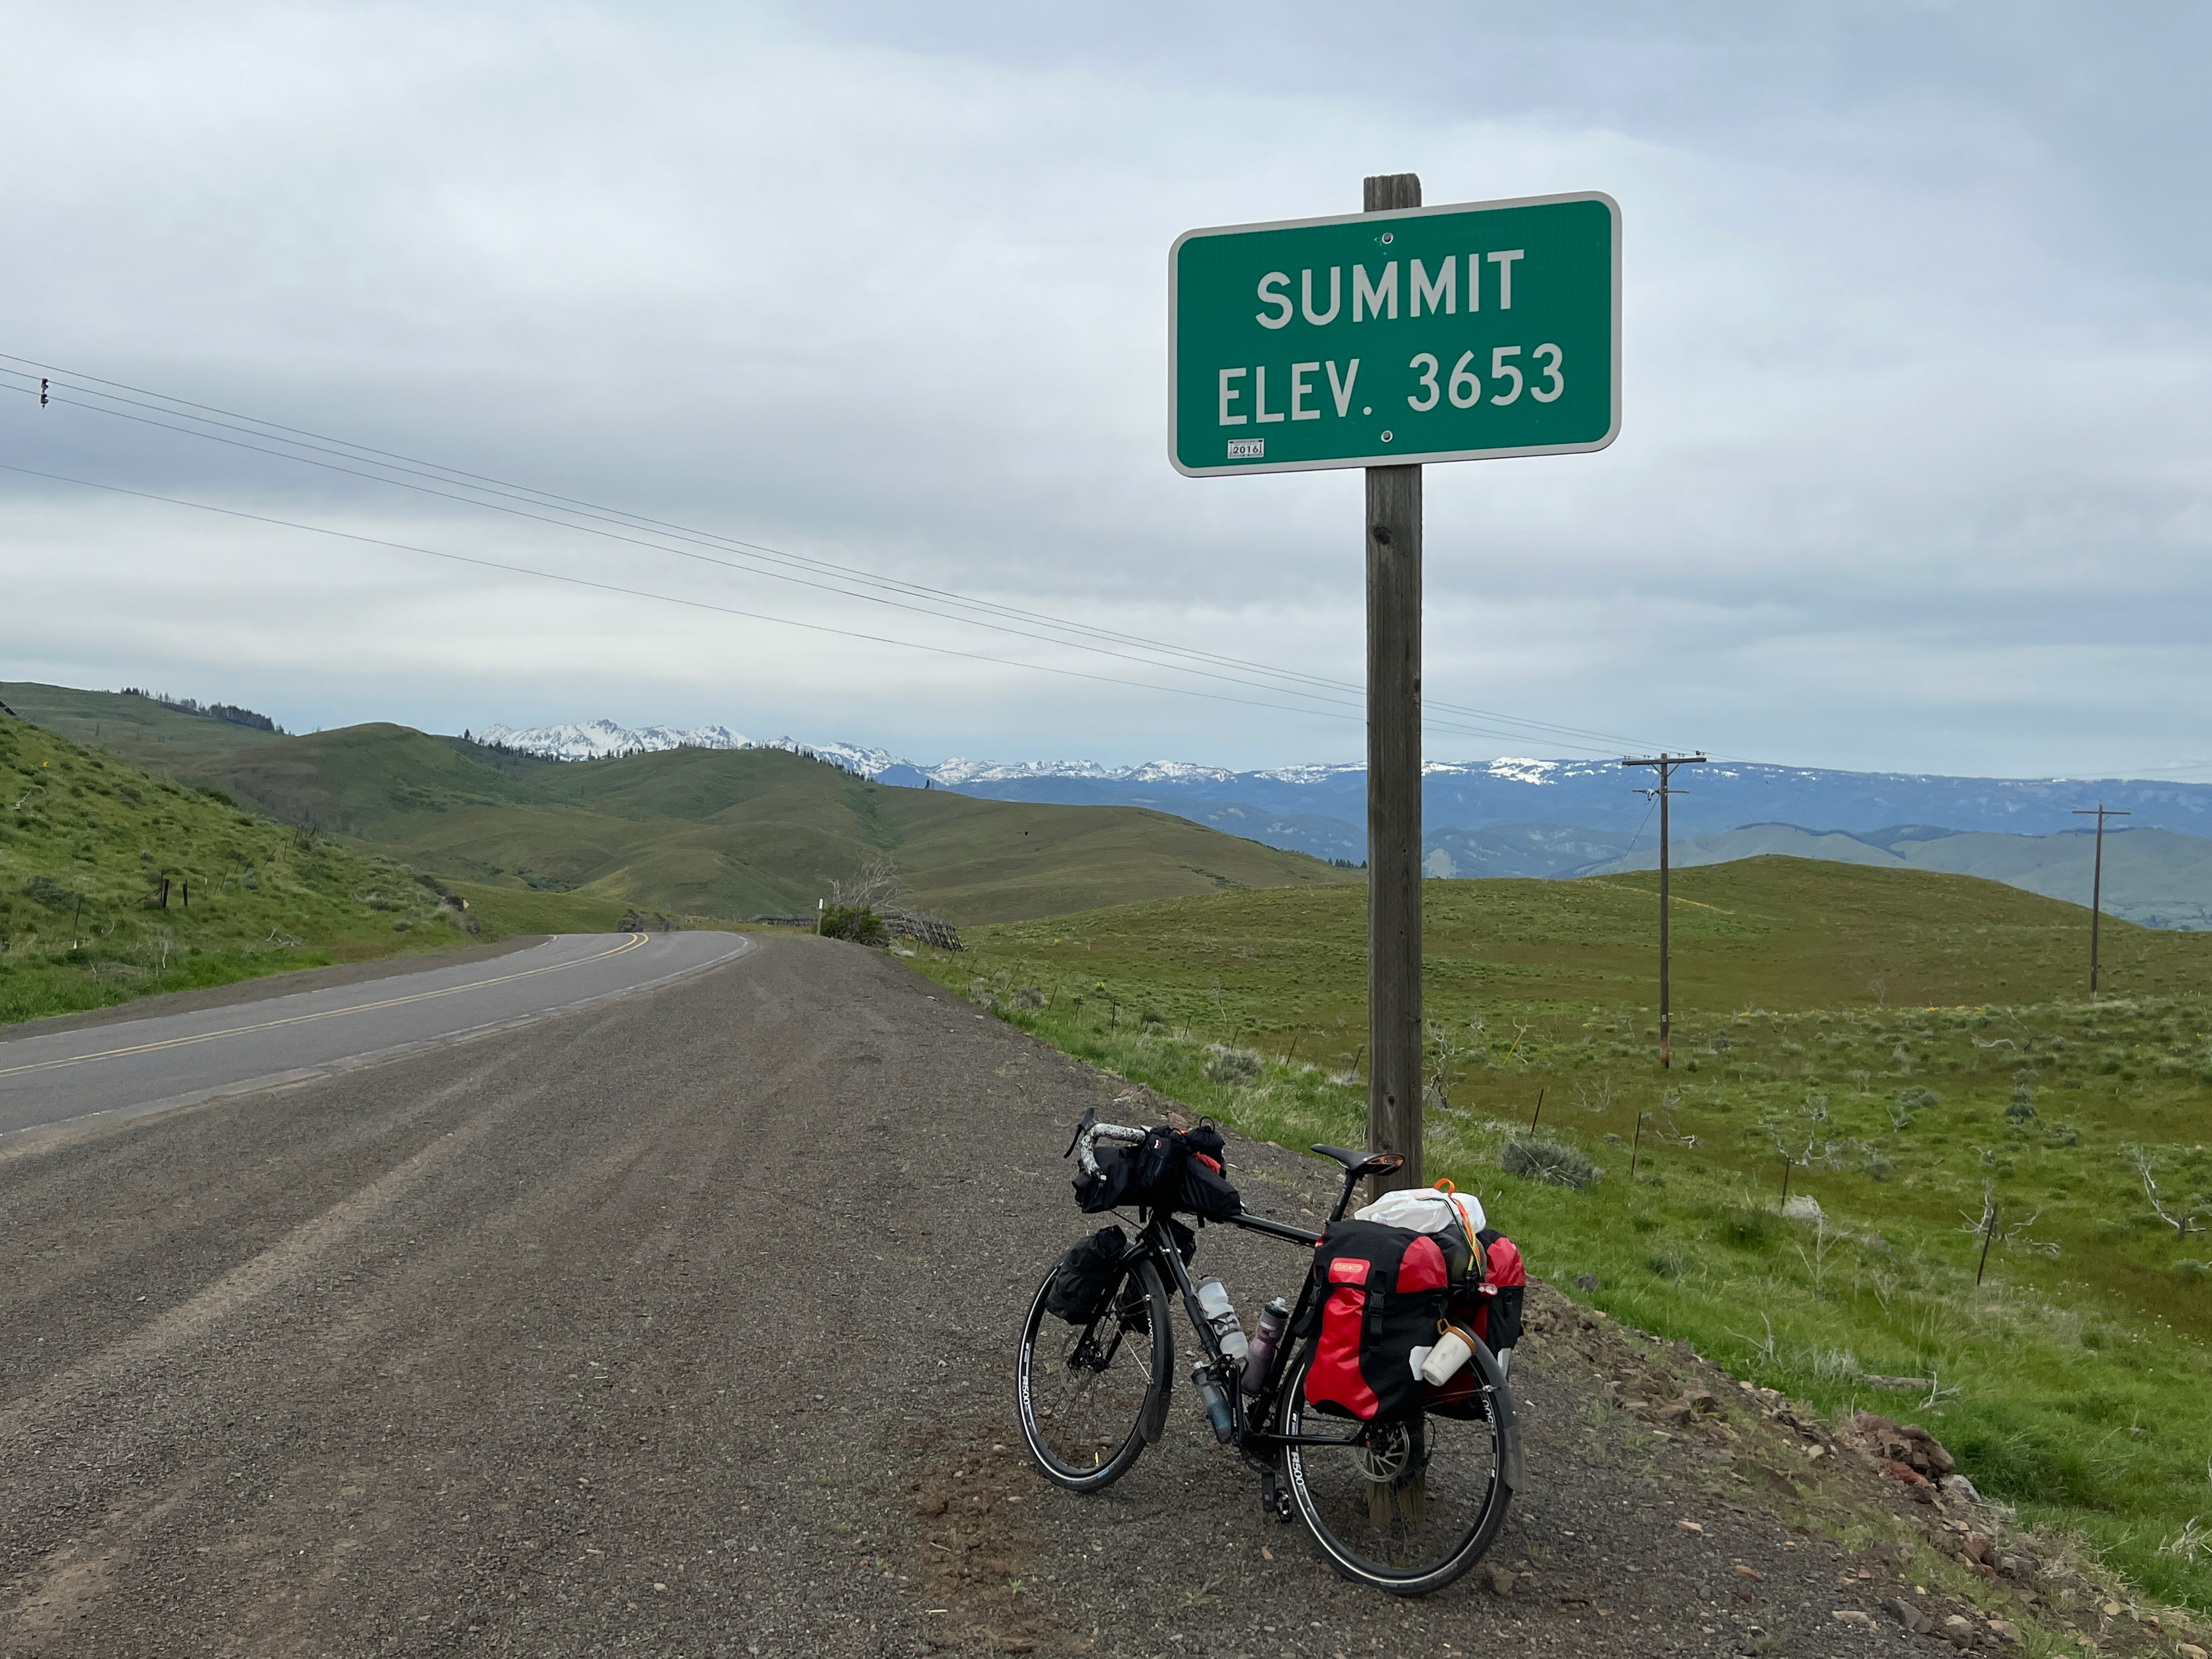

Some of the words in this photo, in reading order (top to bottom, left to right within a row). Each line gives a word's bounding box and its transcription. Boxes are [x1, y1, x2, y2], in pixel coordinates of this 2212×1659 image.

[1256, 249, 1525, 330] SUMMIT
[1219, 358, 1373, 426] ELEV.
[1408, 343, 1565, 411] 3653
[1233, 445, 1259, 454] 2016
[1022, 1375, 1030, 1404] R500
[1291, 1451, 1305, 1486] R500
